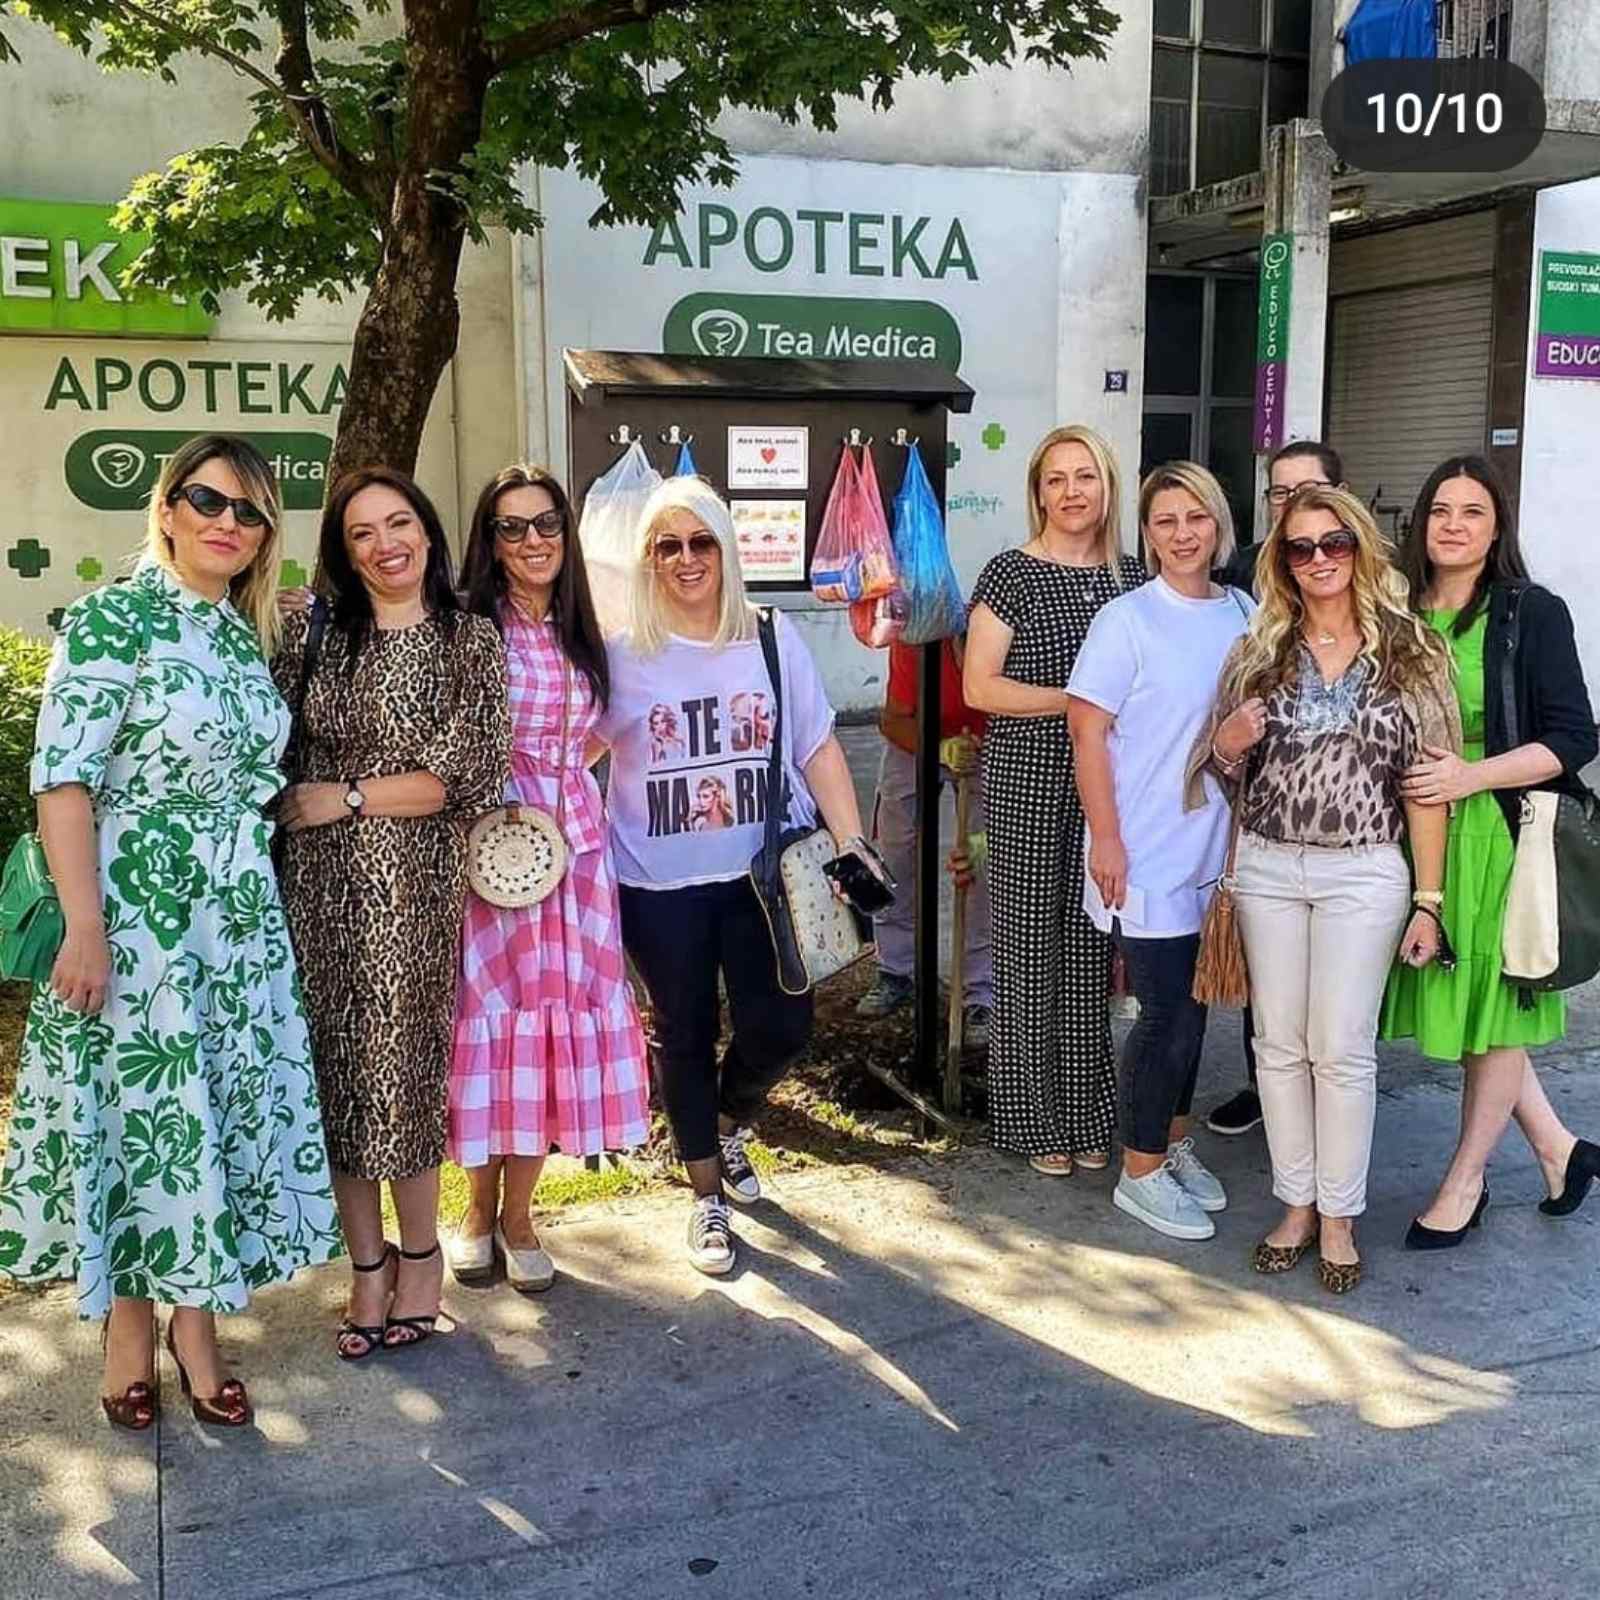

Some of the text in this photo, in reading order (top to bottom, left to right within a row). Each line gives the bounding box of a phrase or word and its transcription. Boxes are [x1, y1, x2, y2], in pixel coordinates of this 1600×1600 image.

[0, 235, 187, 304] EK
[642, 203, 979, 281] APOTEKA
[757, 323, 937, 360] Tea Medica
[1267, 285, 1279, 358] EDUCO
[1547, 341, 1600, 365] EDUC
[44, 356, 350, 415] APOTEKA
[1263, 363, 1275, 449] CENTAR
